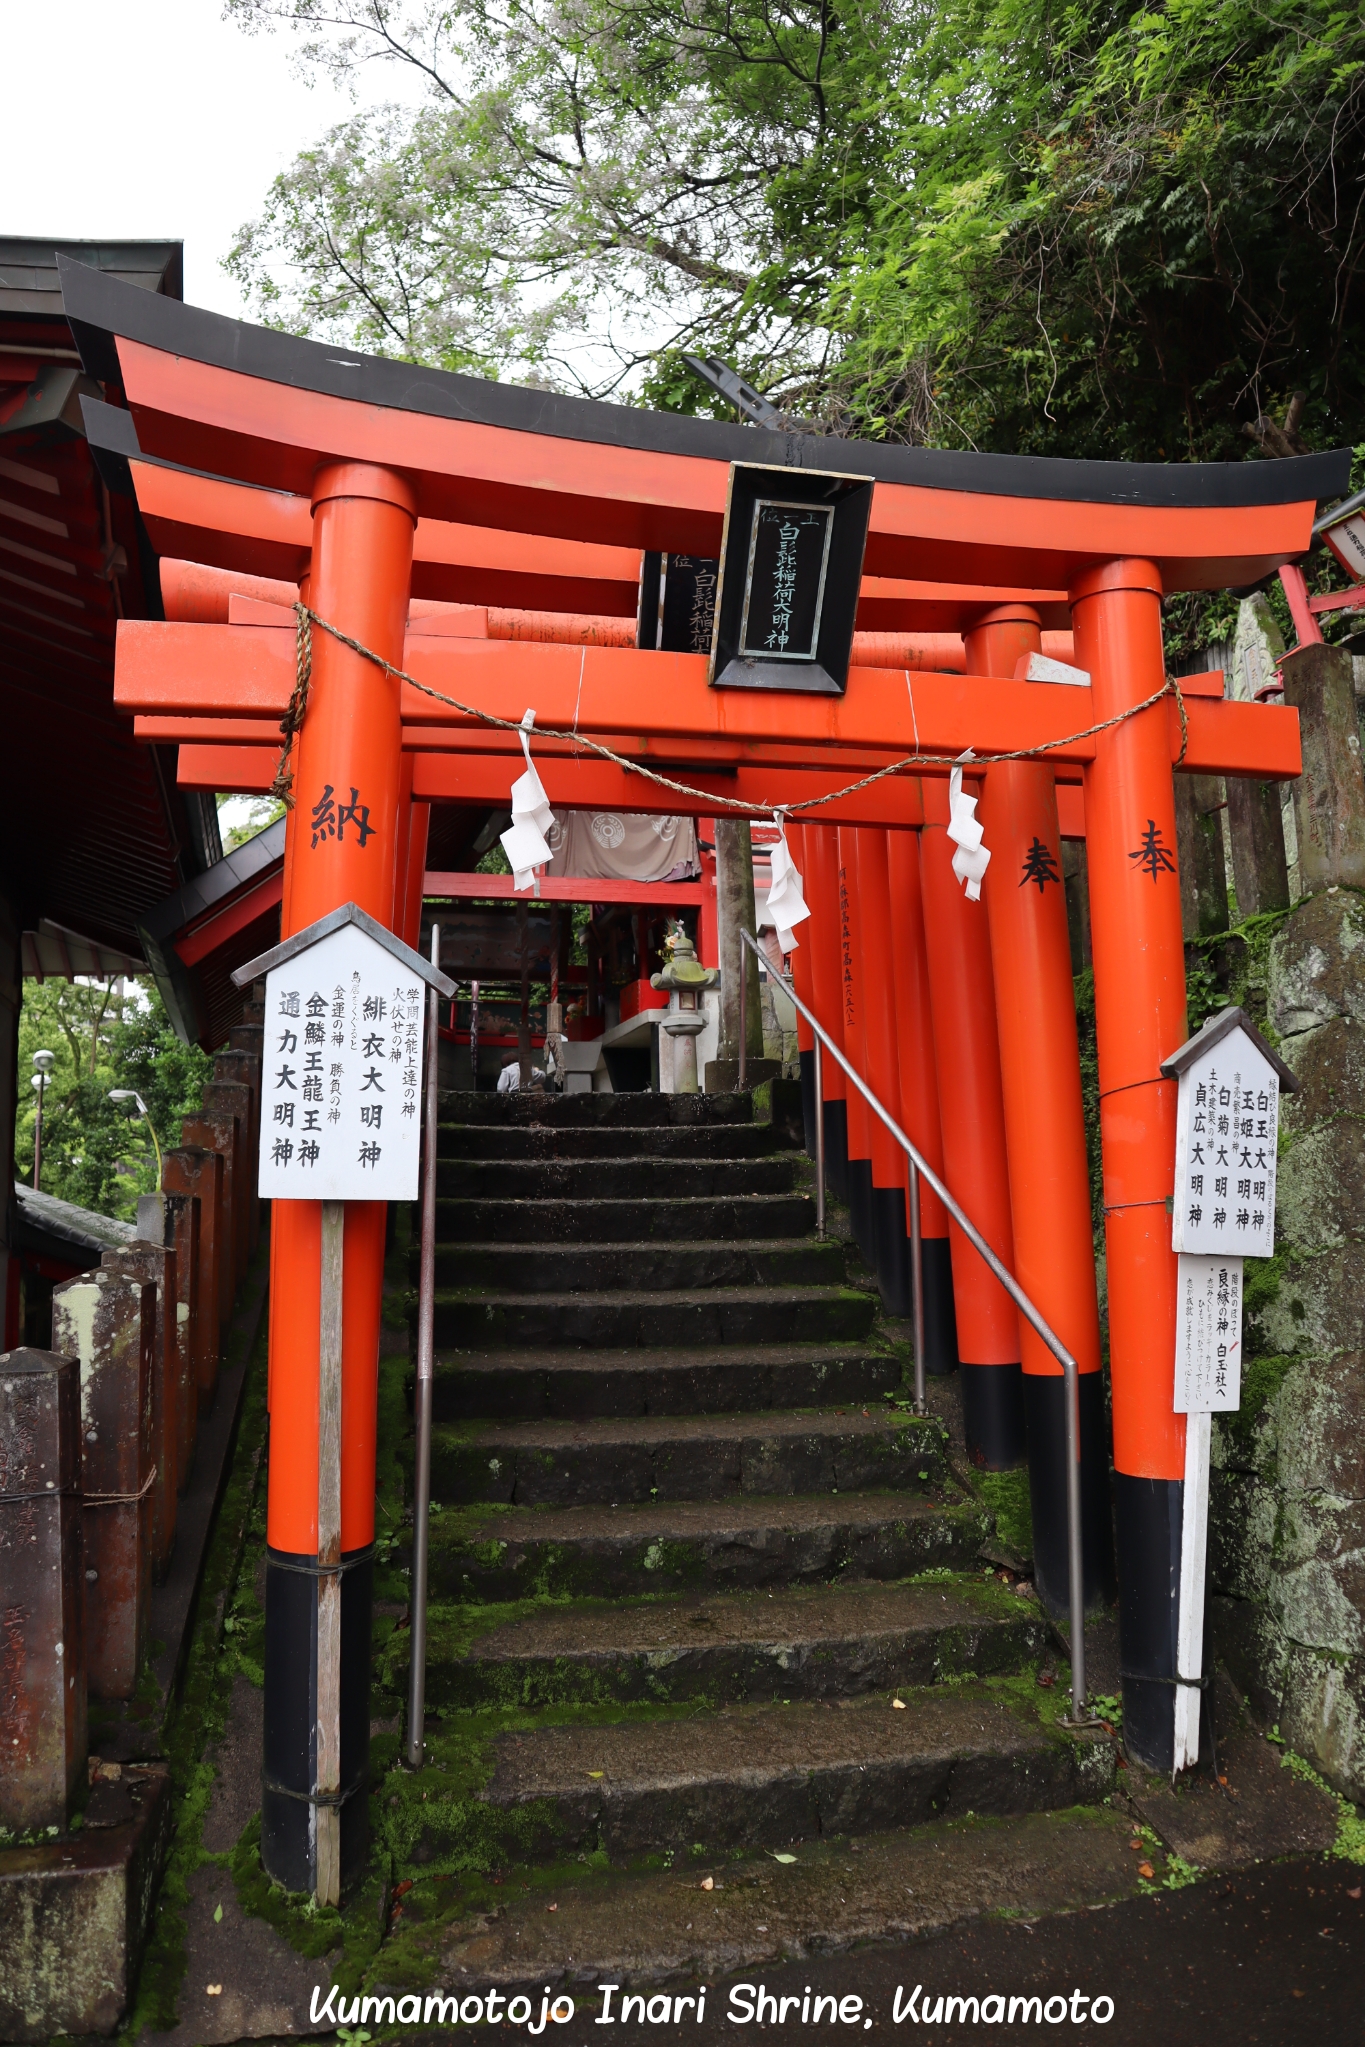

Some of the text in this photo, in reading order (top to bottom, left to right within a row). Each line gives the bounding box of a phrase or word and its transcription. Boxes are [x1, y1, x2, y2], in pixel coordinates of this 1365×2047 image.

[311, 785, 377, 850] 納
[1018, 837, 1060, 894] 奉
[1128, 819, 1177, 884] 奉
[270, 990, 301, 1168] 通力大明神
[297, 991, 329, 1168] 金鱗王龍王神
[327, 984, 346, 1125] 金運の神 勝負の神
[357, 995, 387, 1170] 緋衣大明神
[389, 987, 407, 1064] 火伏せの神
[400, 988, 420, 1119] 学問芸能上達の神
[1188, 1082, 1207, 1228] 貞広大明神
[1207, 1068, 1218, 1151] 土木建築の神
[1212, 1085, 1231, 1230] 白菊大明神
[1235, 1090, 1255, 1231] 玉姫大明神
[1252, 1090, 1269, 1232] 白玉大明神
[1214, 1268, 1231, 1397] 良縁の神 白玉社へ
[1230, 1272, 1240, 1337] 階段のぼって
